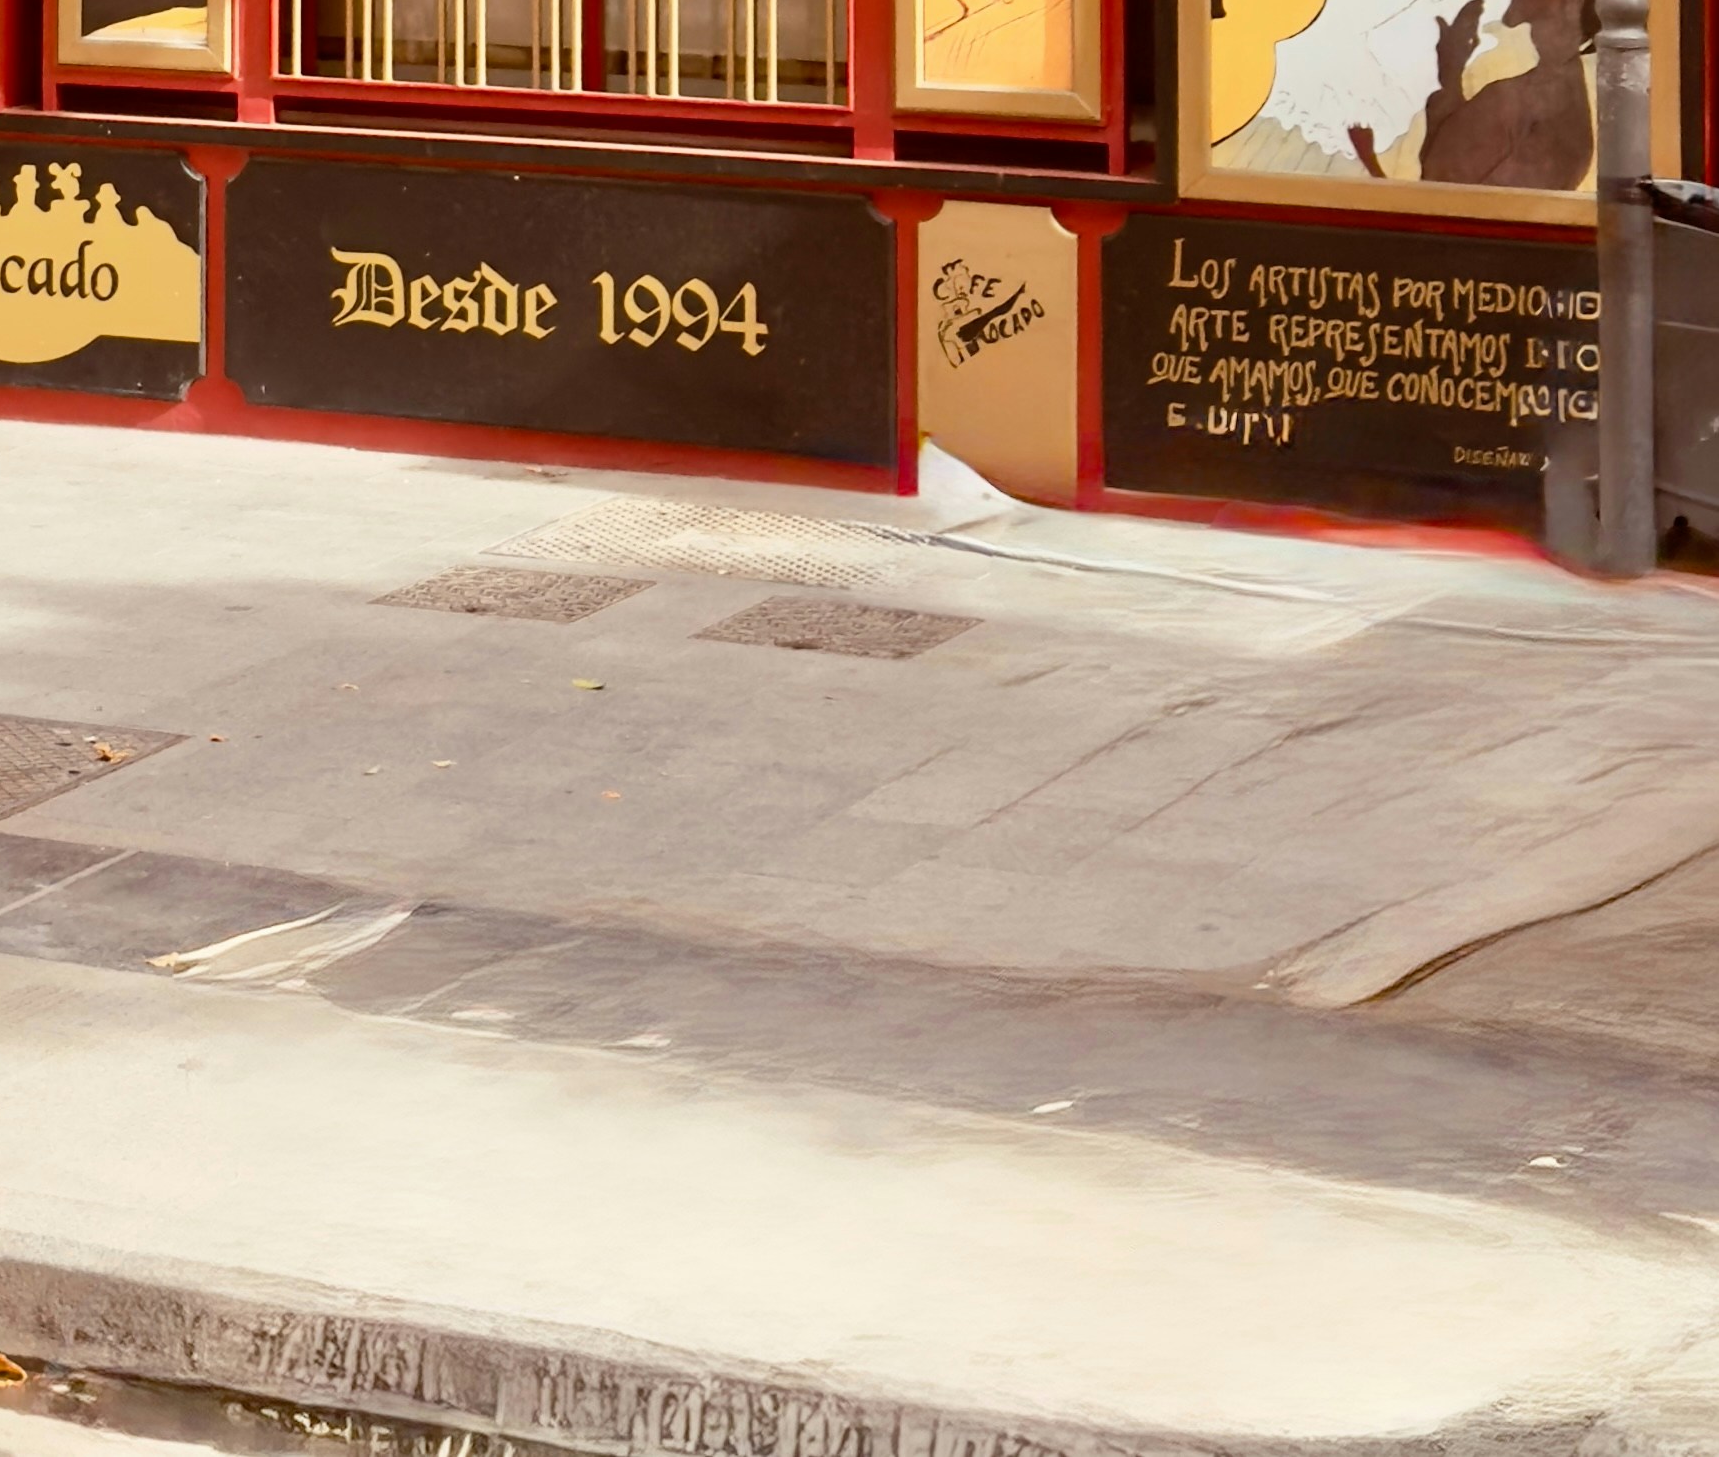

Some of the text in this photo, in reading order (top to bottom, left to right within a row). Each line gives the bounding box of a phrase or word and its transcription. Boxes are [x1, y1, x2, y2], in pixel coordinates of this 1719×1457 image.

[331, 246, 769, 357] Desde 1994
[1249, 264, 1380, 319] ARTISTAS
[1392, 276, 1445, 319] POR
[1170, 303, 1249, 352] ARTE
[1146, 351, 1202, 386] QUE
[1323, 365, 1380, 400] QUE
